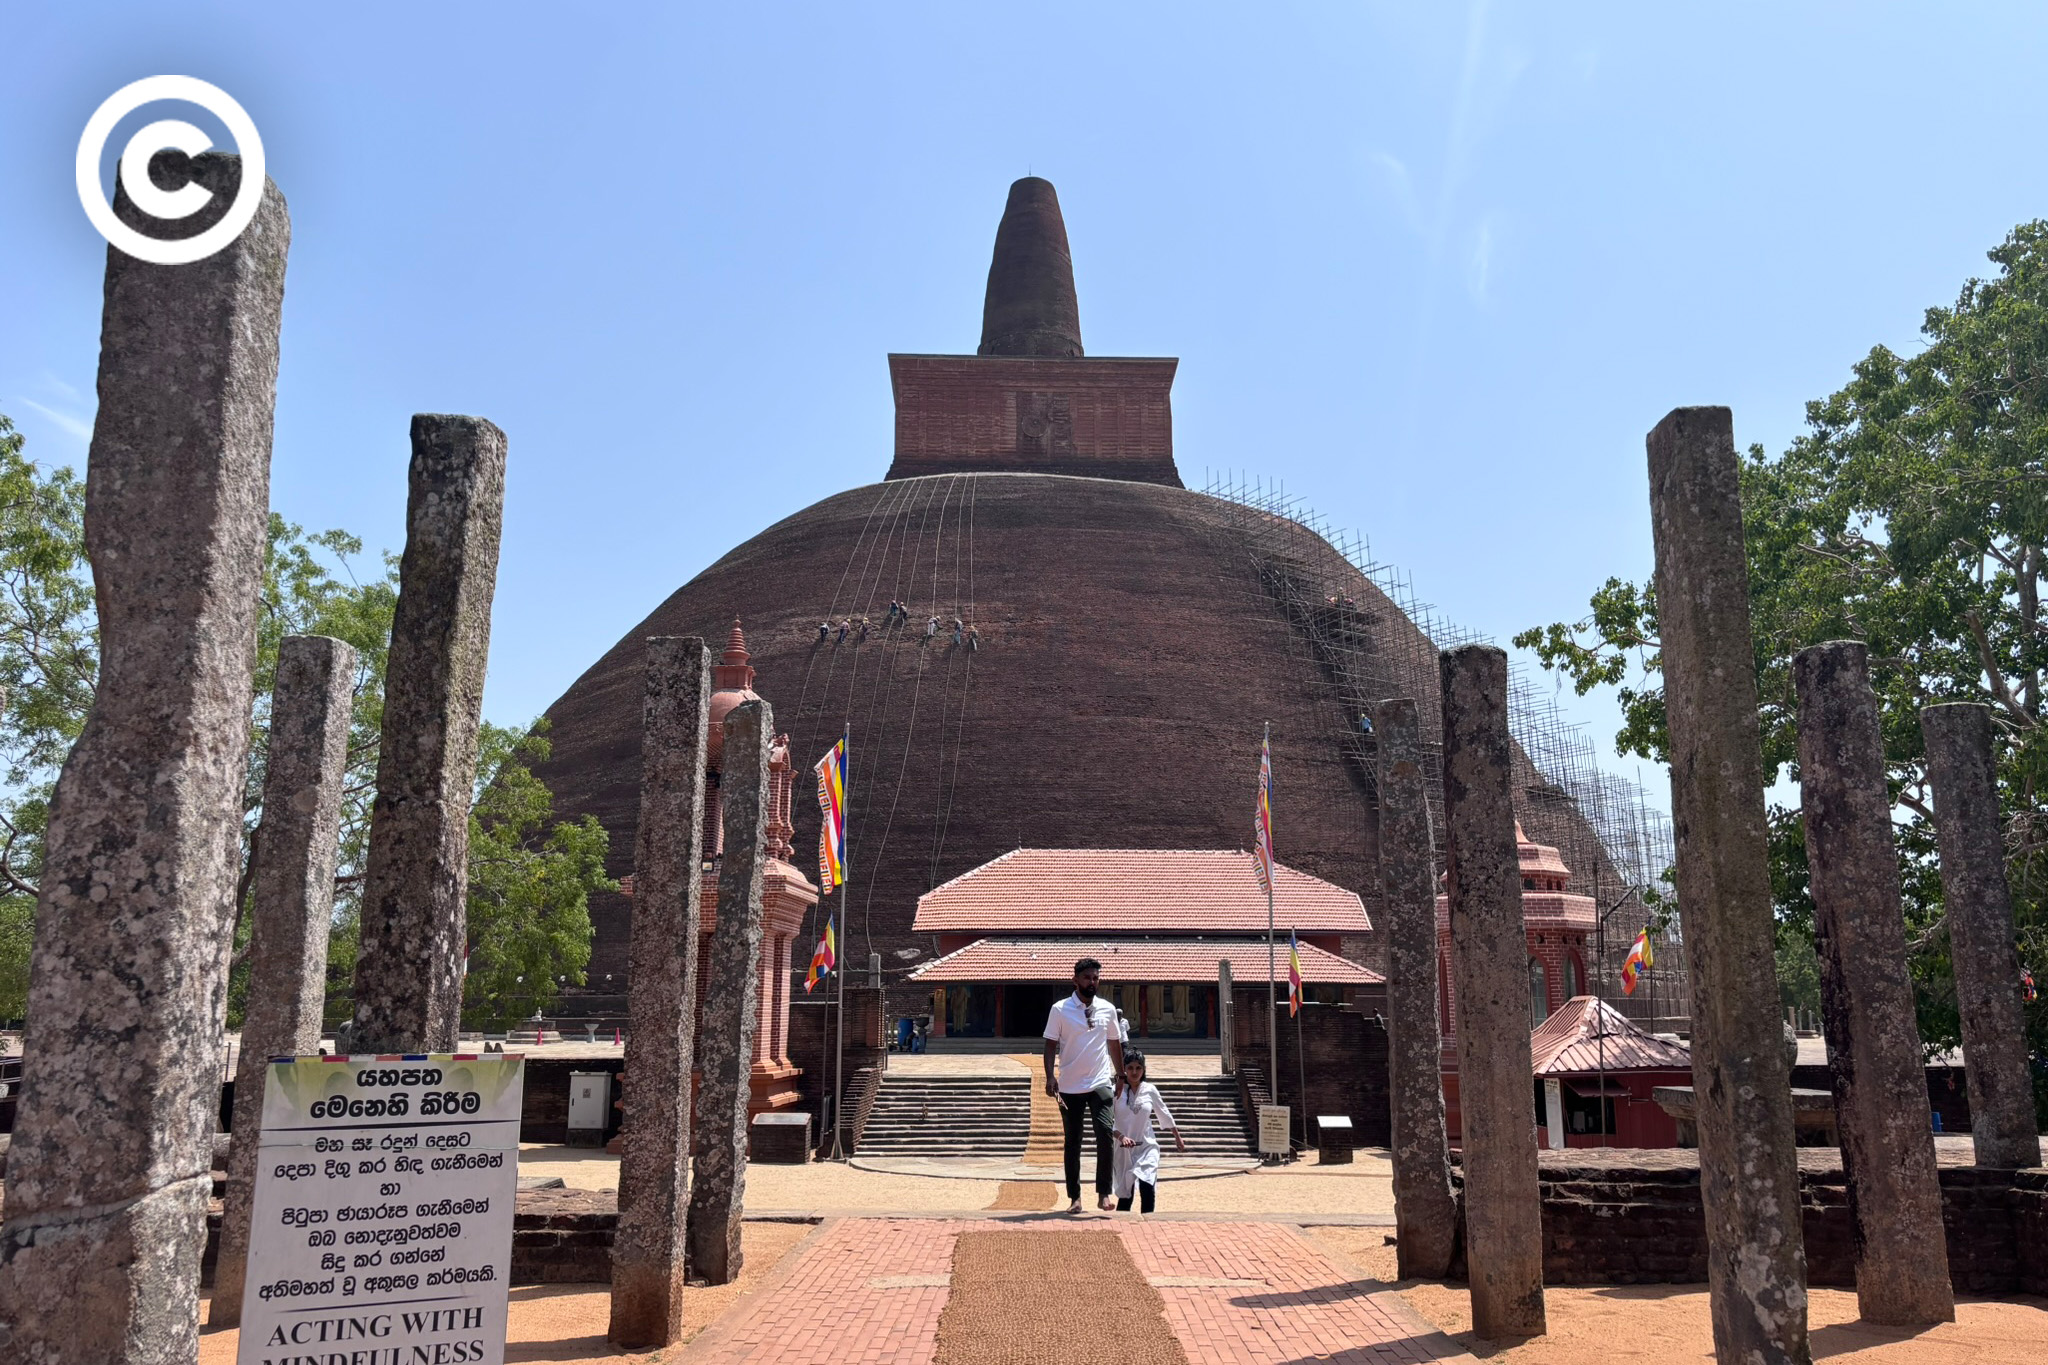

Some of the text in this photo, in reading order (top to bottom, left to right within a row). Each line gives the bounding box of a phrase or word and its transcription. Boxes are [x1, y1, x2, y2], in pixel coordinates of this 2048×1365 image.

[357, 1069, 442, 1086] යහපත
[310, 1093, 408, 1118] මෙනෙහි
[426, 1132, 471, 1151] දෙසට
[274, 1164, 316, 1181] දෙපා
[325, 1159, 350, 1179] දිගු
[359, 1157, 386, 1174] කර
[380, 1183, 400, 1196] හා
[281, 1208, 328, 1228] පිටුපා
[308, 1222, 461, 1247] ඔබ නොදැනුවත්වම
[321, 1246, 445, 1273] සිදු කර ගන්නේ
[259, 1277, 334, 1302] අතිමහත්
[364, 1274, 419, 1293] අකුසල
[267, 1307, 483, 1346] ACTING WITH
